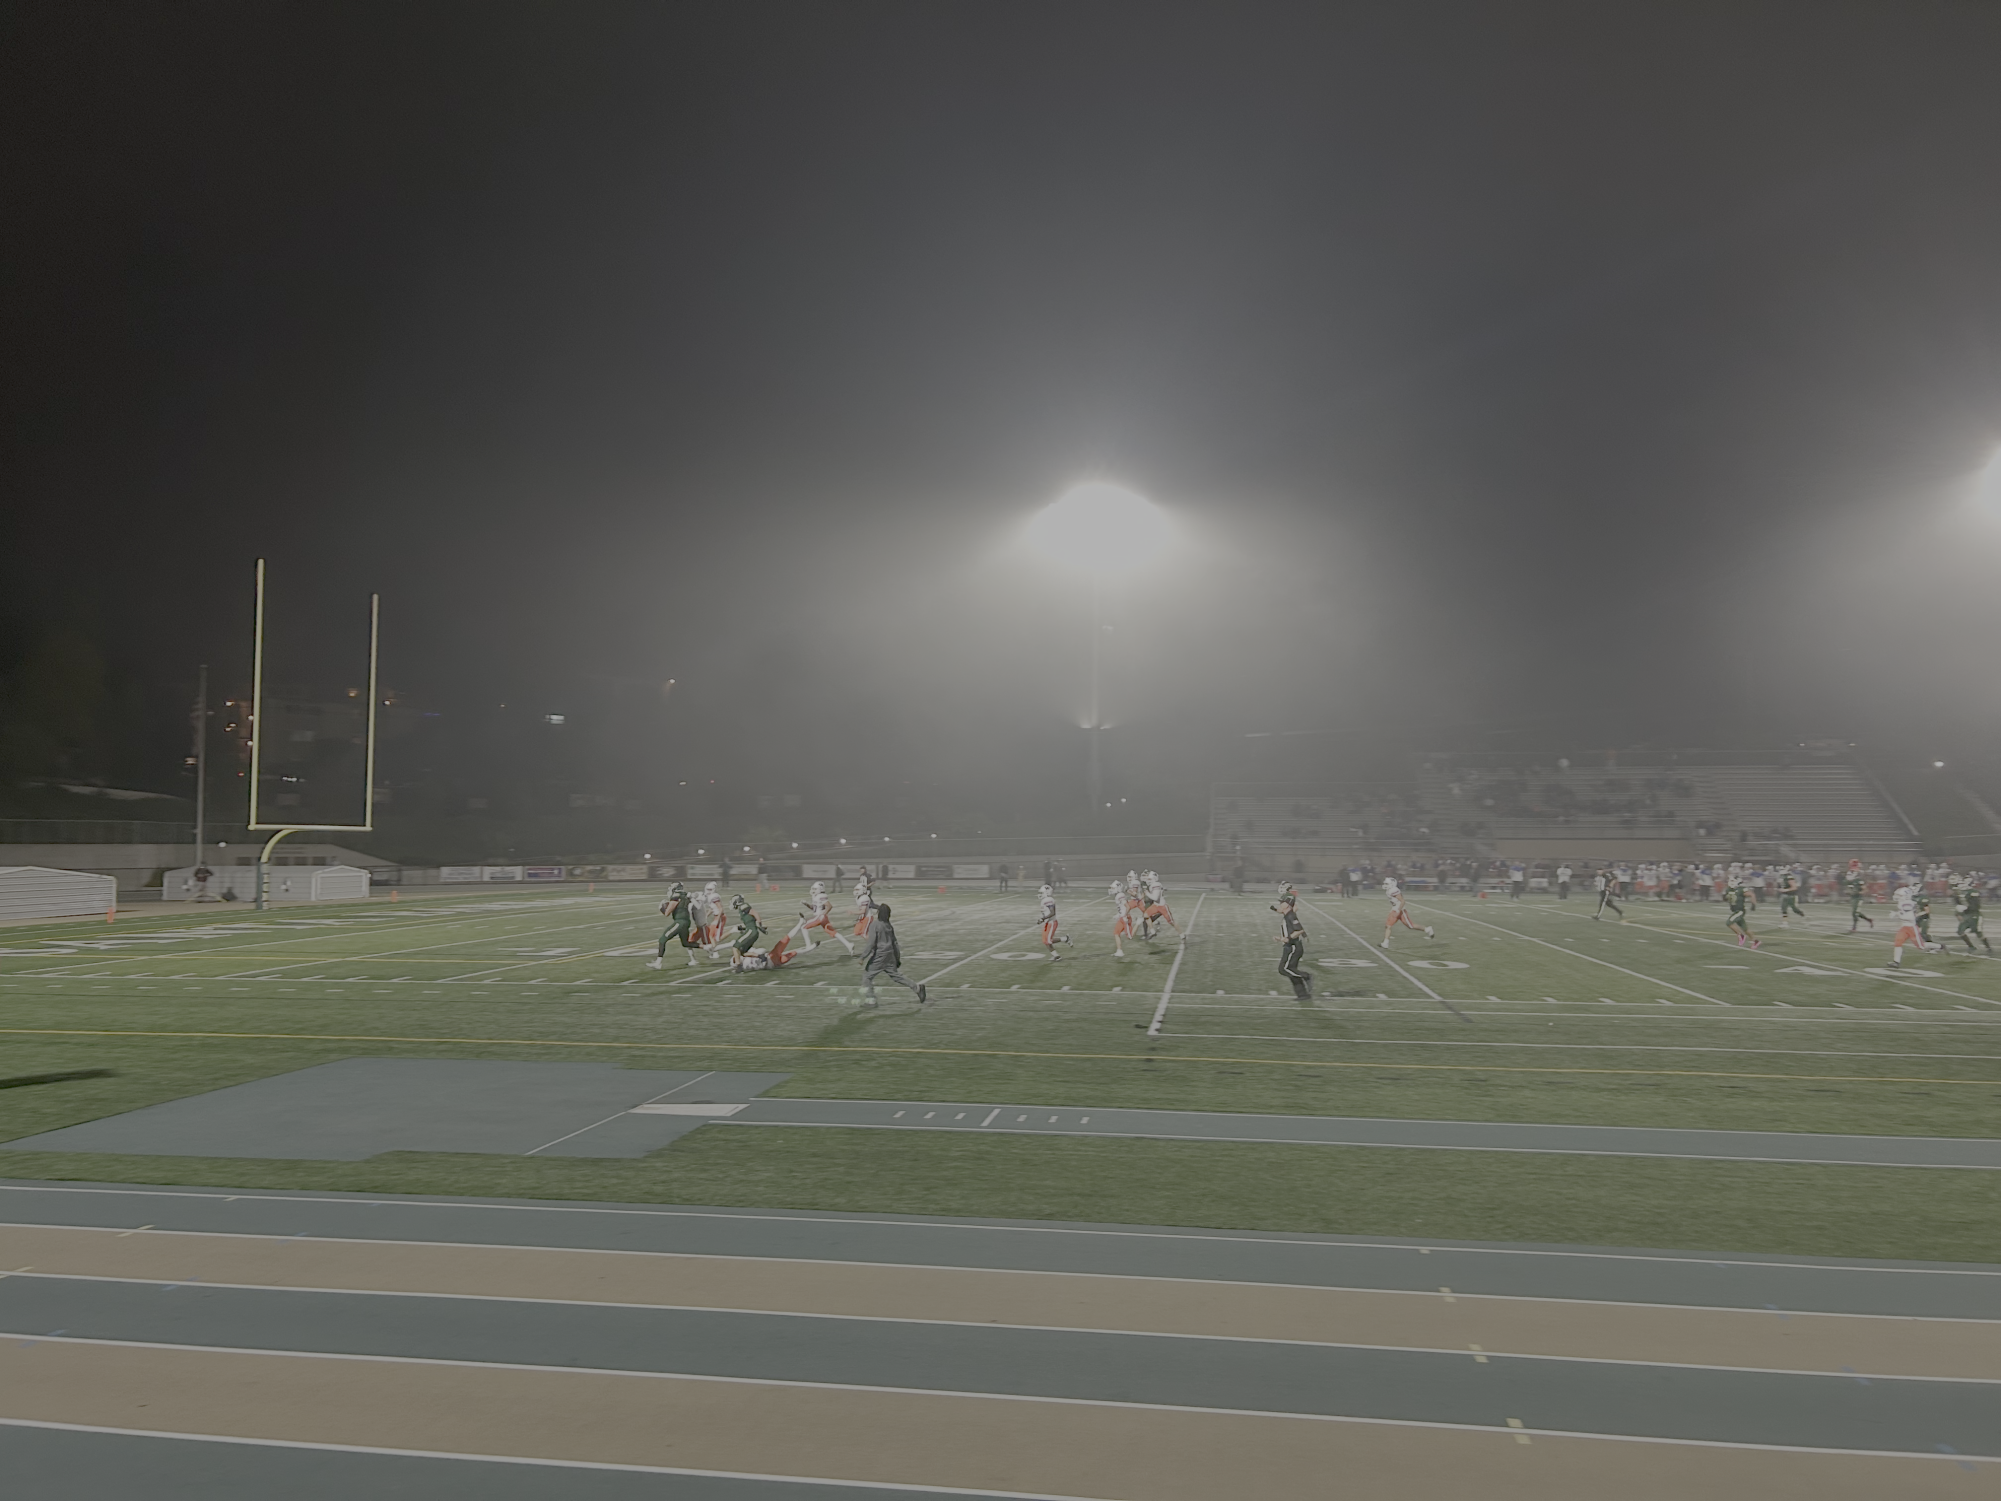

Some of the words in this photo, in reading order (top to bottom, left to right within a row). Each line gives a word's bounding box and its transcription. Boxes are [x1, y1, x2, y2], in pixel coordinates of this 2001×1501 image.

[899, 950, 1046, 960] 20
[1316, 958, 1470, 969] 30
[1774, 965, 1946, 978] 40
